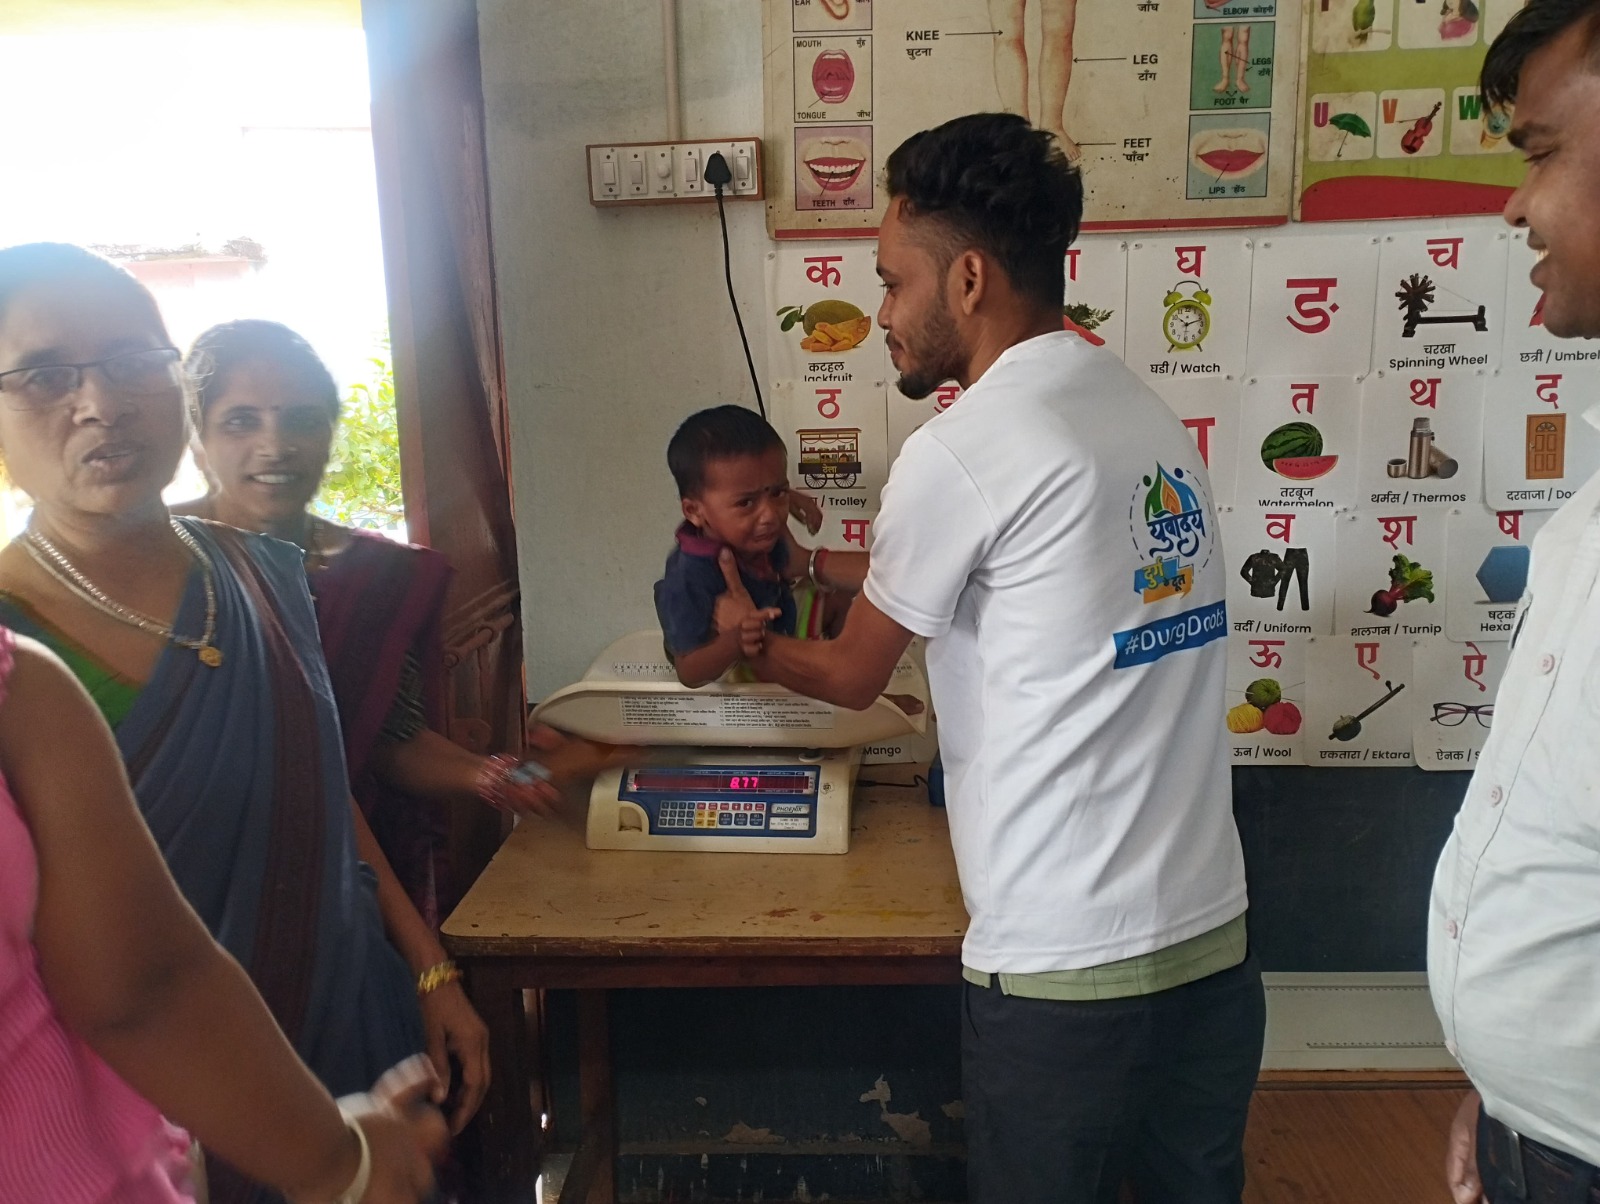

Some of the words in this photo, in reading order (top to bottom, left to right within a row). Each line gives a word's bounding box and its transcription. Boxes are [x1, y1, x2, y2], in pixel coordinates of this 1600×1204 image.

[1222, 7, 1249, 15] ELBOW
[905, 30, 940, 41] KNEE
[796, 40, 822, 48] MOUTH
[906, 47, 932, 60] घुटना
[1133, 54, 1159, 65] LEG
[1252, 57, 1271, 66] LEGS
[1137, 69, 1157, 81] टाँग
[1214, 97, 1236, 106] FOOT
[1458, 95, 1483, 121] W
[797, 111, 826, 119] TONGUE
[856, 110, 871, 119] जीभ
[1313, 102, 1329, 128] U
[1382, 98, 1398, 124] V
[1123, 138, 1152, 148] FEET
[1208, 186, 1226, 195] LIPS
[812, 199, 836, 207] TEETH
[1426, 237, 1464, 270] च
[1175, 245, 1206, 278] घ
[803, 256, 843, 288] क
[1423, 343, 1456, 355] चरखा
[808, 361, 845, 373] कटहल
[1180, 363, 1221, 373] Watch
[1389, 358, 1445, 370] Spinning
[1448, 354, 1488, 366] Wheel
[1409, 378, 1442, 409] थ
[1535, 374, 1563, 409] द
[815, 388, 842, 419] ठ
[1290, 383, 1319, 415] त
[1280, 487, 1315, 500] तरबूज
[1370, 490, 1401, 503] थर्मस
[1412, 492, 1467, 503] Thermos
[1506, 490, 1545, 501] दरवाजा
[828, 497, 867, 508] Trolley
[1265, 514, 1296, 543] व
[1496, 510, 1524, 541] ष
[841, 519, 870, 549] म
[1377, 515, 1418, 550] श
[1170, 574, 1186, 592] दूत
[1124, 609, 1225, 655] #DurgDoots
[1233, 620, 1255, 633] वर्दी
[1263, 622, 1312, 634] Uniform
[1350, 625, 1392, 637] शलगम
[1402, 623, 1442, 636] Turnip
[1480, 622, 1513, 632] Hexa
[1248, 640, 1286, 669] ऊ
[1354, 642, 1381, 680] ए
[1462, 641, 1488, 692] ऐ
[863, 746, 902, 757] Mango
[1233, 747, 1252, 757] ऊन
[1262, 747, 1292, 757] Wool
[1319, 750, 1362, 760] एकतारा
[1372, 750, 1411, 759] Ektara
[1435, 749, 1465, 761] ऐनक
